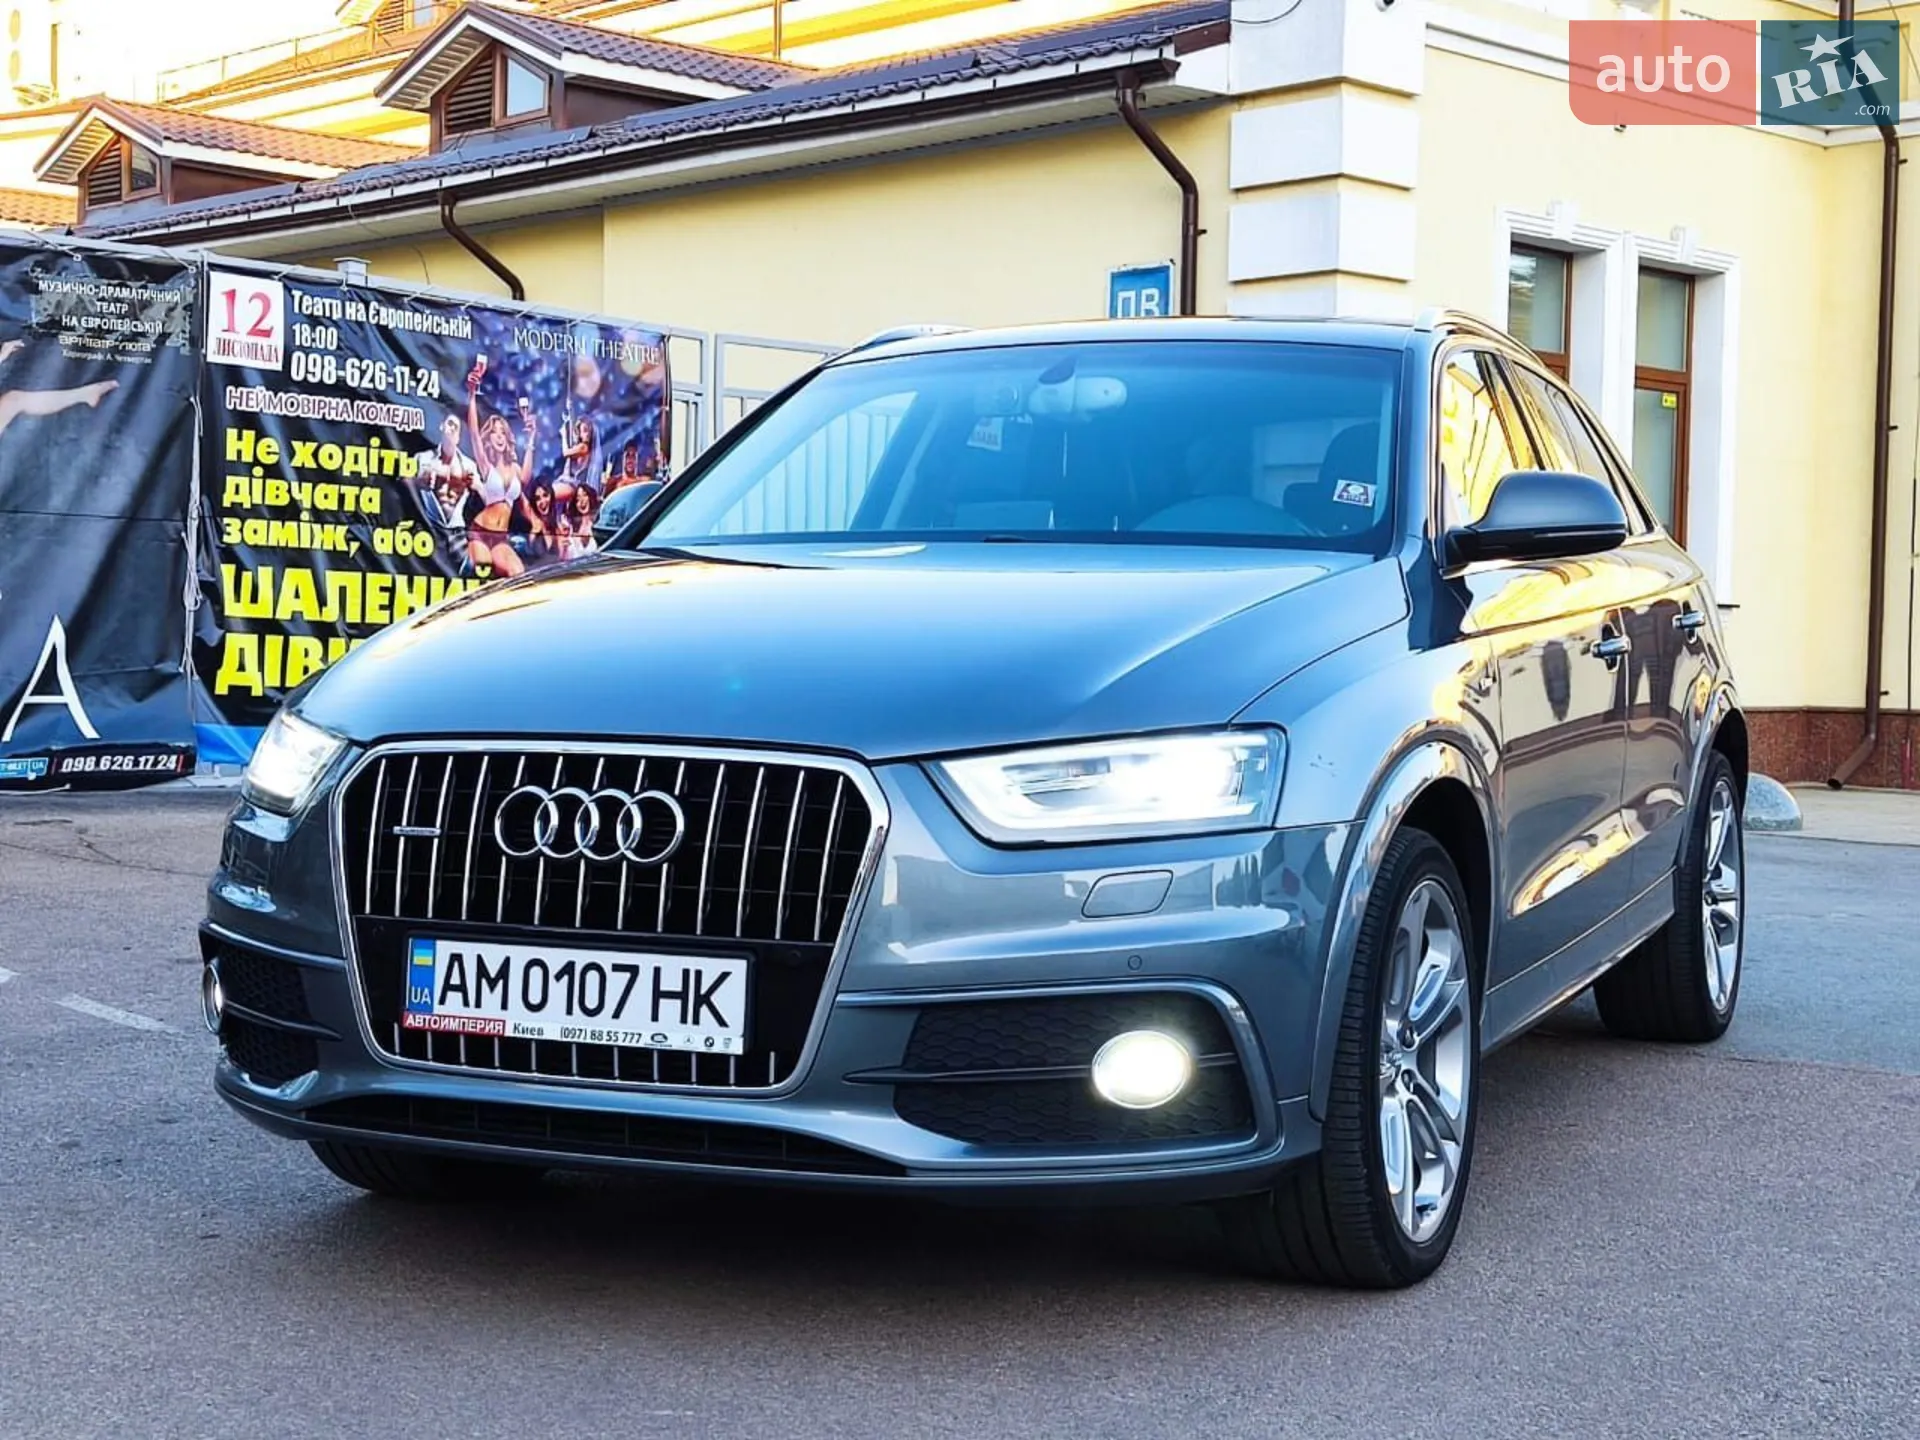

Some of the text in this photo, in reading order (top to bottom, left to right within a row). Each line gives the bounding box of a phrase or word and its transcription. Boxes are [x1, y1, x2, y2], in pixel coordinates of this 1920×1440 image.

[38, 280, 181, 302] МУЗИЧНО-ДРАМАТИЧНИЙ
[96, 301, 129, 315] ТЕАТР
[220, 288, 275, 339] 12
[62, 315, 79, 327] НА
[291, 289, 472, 340] Театр на Європейській
[292, 324, 338, 350] 18:00
[212, 337, 280, 363] ЛИСТОПАДА
[514, 326, 660, 366] MODERN THEATRE
[290, 351, 441, 399] 098-626-17-24
[226, 386, 425, 432] НЕЙМОВІРНА КОМЕДІЯ
[225, 427, 419, 478] Не ходіть
[222, 466, 381, 515] дівчата
[222, 512, 435, 559] заміж, або
[220, 564, 492, 624] ШАЛЕН
[411, 986, 432, 1005] UA
[438, 952, 733, 1028] AM 0107 HK
[405, 1013, 505, 1035] АВТОИМПЕРИЯ
[513, 1022, 545, 1037] Киев
[560, 1026, 588, 1040] (097)
